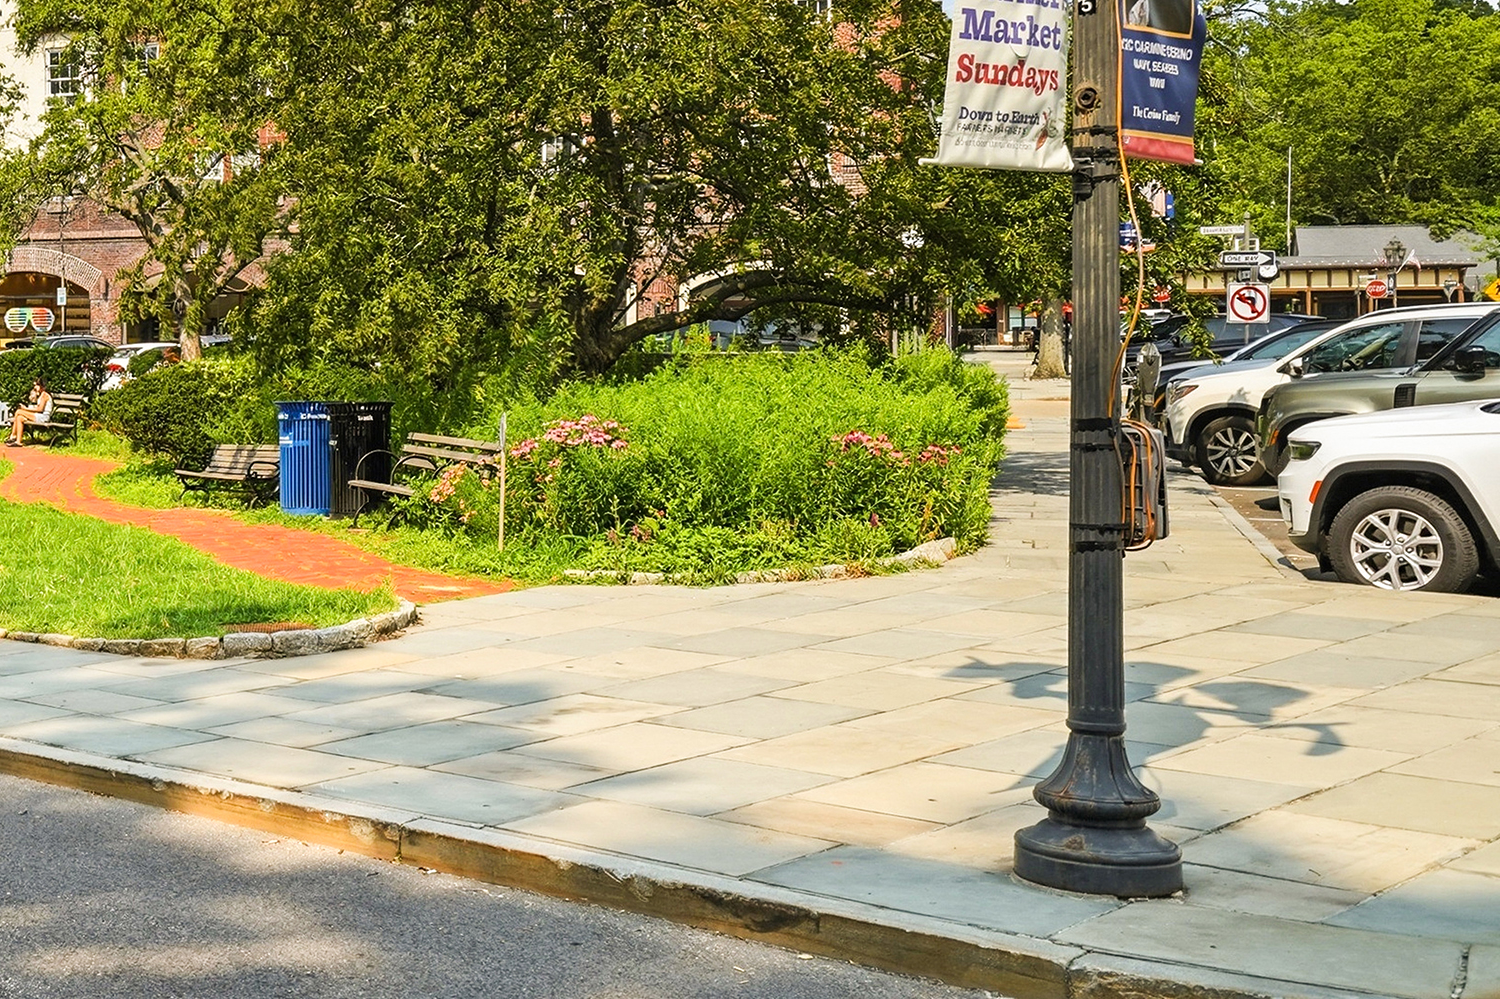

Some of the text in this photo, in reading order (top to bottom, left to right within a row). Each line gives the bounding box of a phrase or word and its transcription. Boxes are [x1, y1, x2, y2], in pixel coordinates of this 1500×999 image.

[959, 8, 1061, 50] Market
[956, 53, 1058, 96] Sundays
[959, 106, 1040, 125] Down to Earth
[1133, 105, 1143, 117] The
[1226, 254, 1242, 262] ONE
